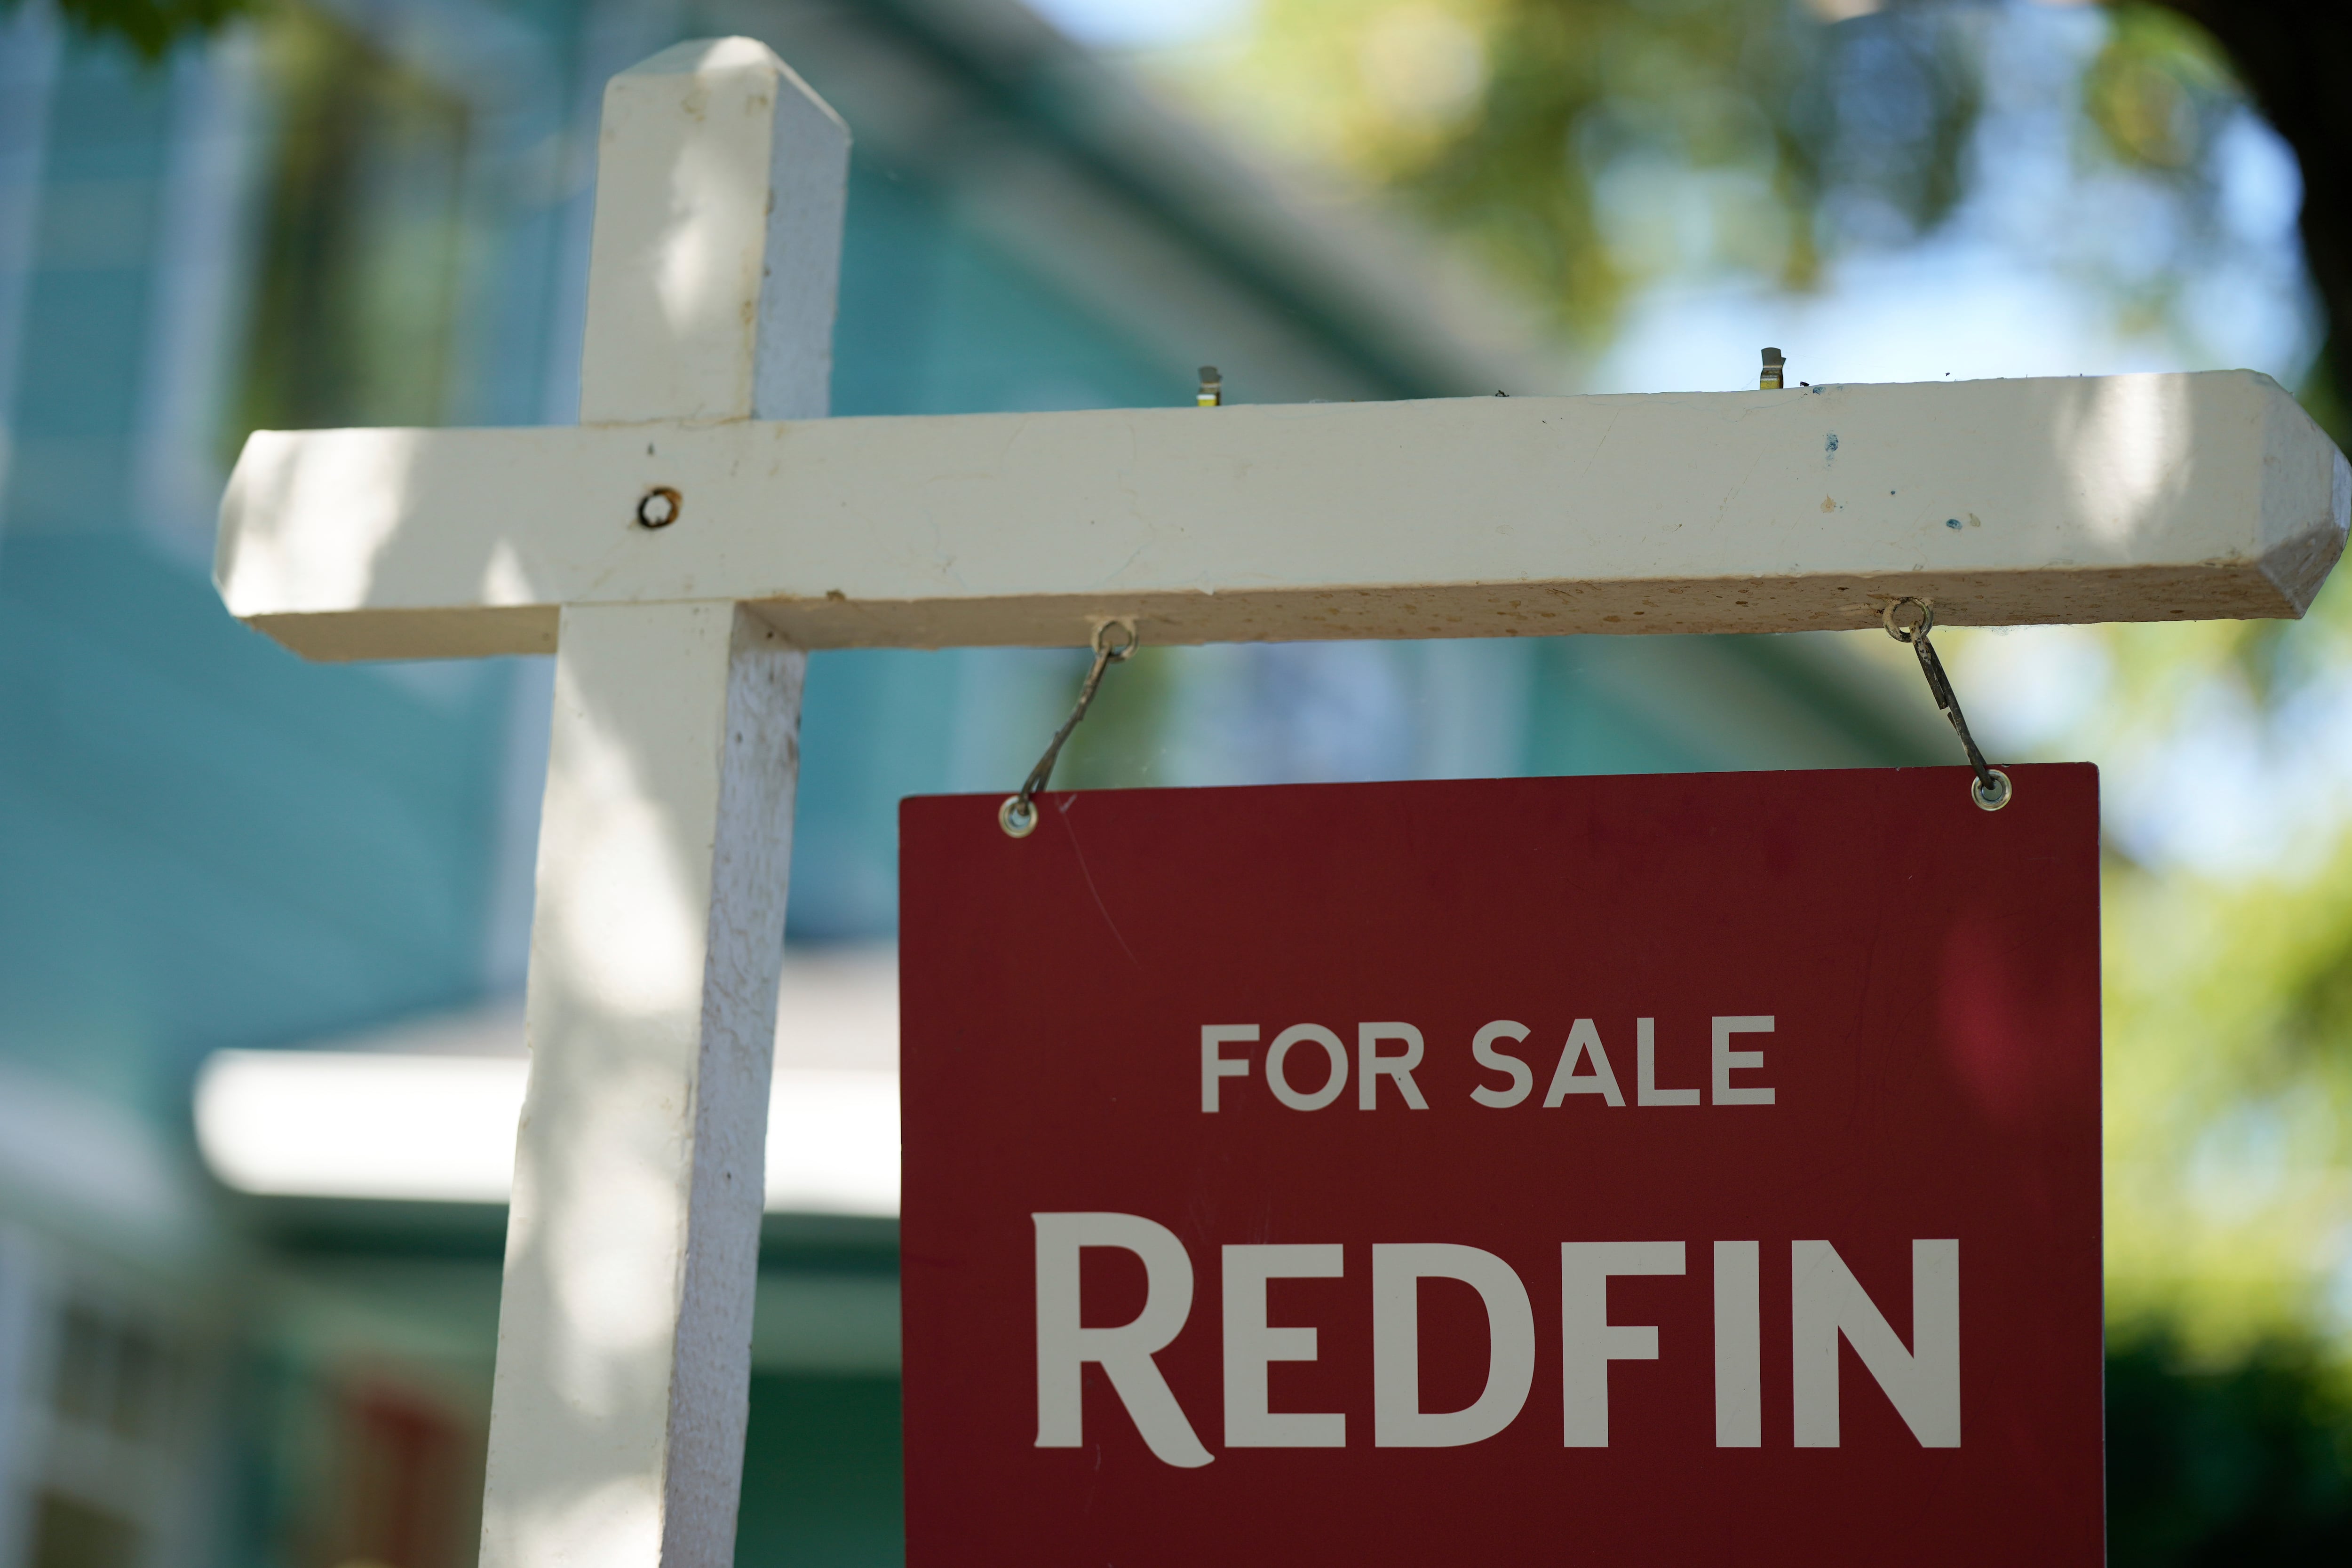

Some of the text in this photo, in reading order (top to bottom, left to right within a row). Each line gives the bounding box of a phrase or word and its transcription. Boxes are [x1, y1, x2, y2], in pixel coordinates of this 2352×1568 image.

[1201, 1015, 1775, 1113] FOR SALE
[1031, 1212, 1961, 1468] REDFIN
